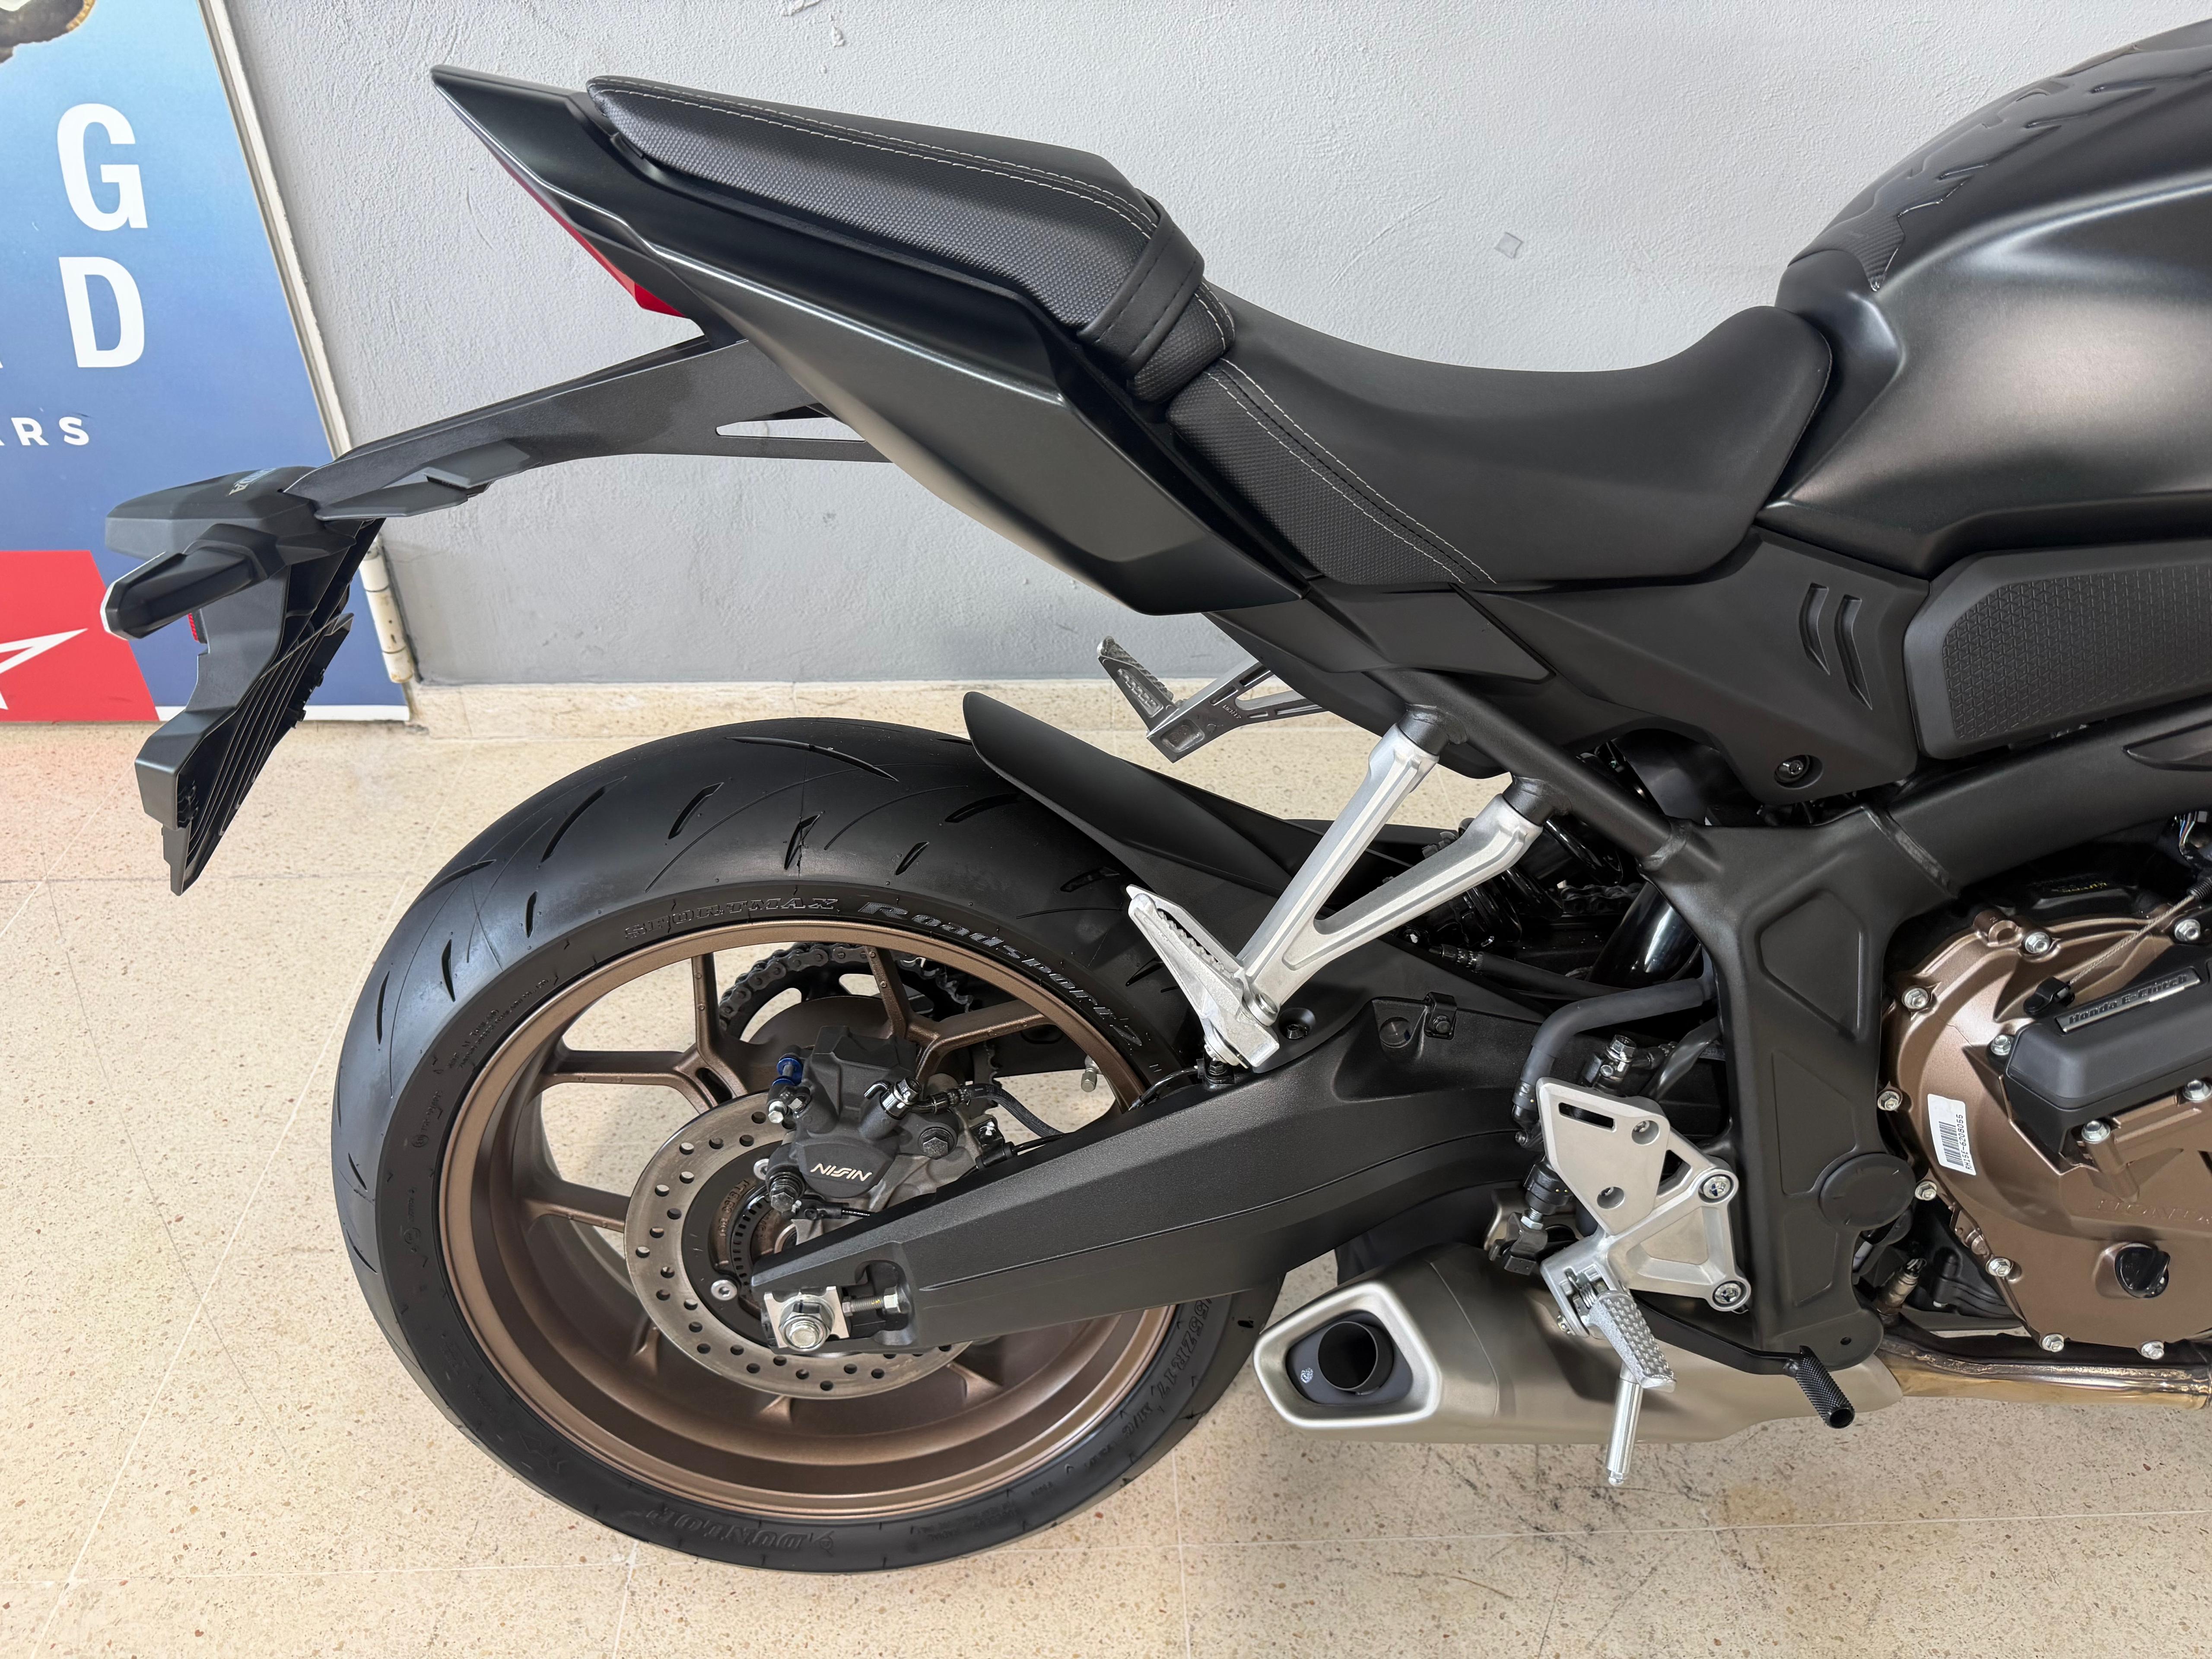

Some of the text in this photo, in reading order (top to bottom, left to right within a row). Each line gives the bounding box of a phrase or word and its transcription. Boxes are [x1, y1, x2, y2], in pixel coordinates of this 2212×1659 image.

[57, 103, 148, 231] G
[0, 416, 89, 446] RS
[624, 898, 838, 939] SPORTMAX
[2069, 974, 2187, 1024] Honda E-Clutch
[646, 1506, 807, 1550] DUNLOP
